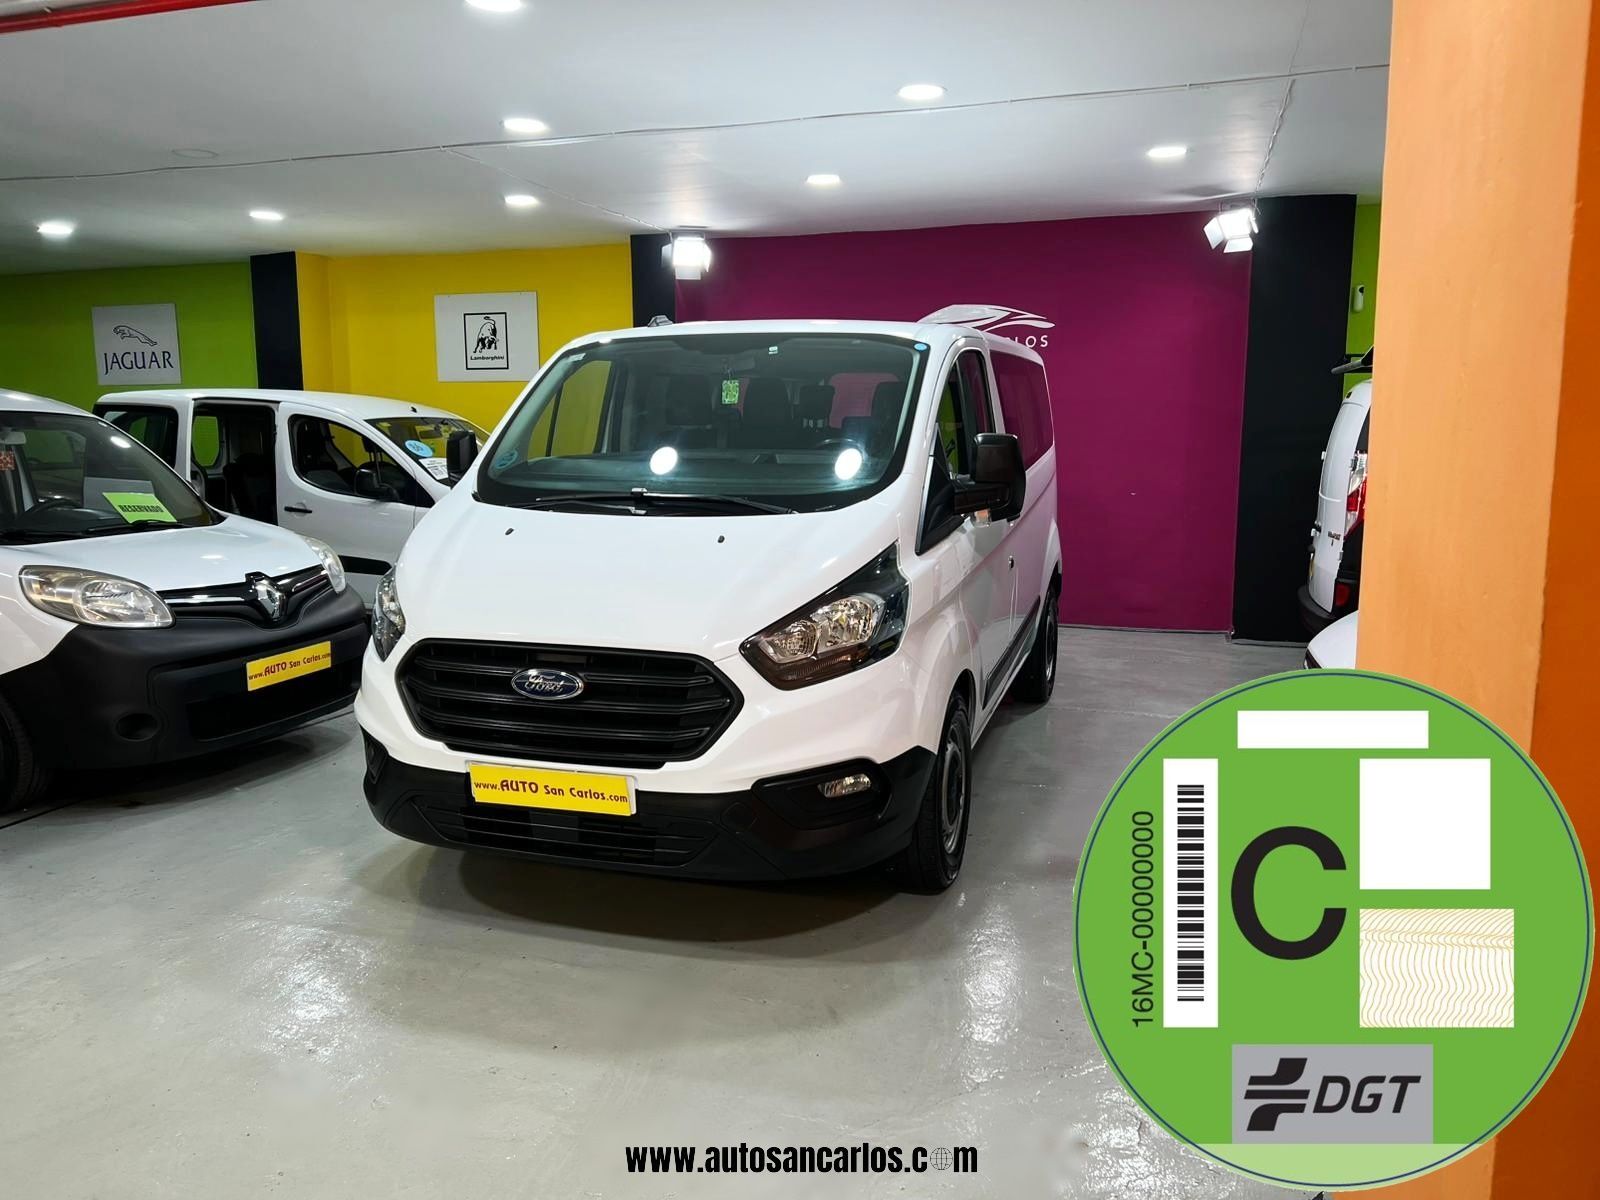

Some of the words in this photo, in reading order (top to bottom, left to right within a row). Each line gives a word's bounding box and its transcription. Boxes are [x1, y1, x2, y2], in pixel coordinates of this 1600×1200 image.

[104, 351, 174, 375] JAGUAR
[248, 661, 287, 680] www.AUTO
[289, 660, 301, 669] San
[474, 779, 539, 794] www.AUTO
[544, 784, 565, 797] San
[569, 787, 628, 803] Carlos.com
